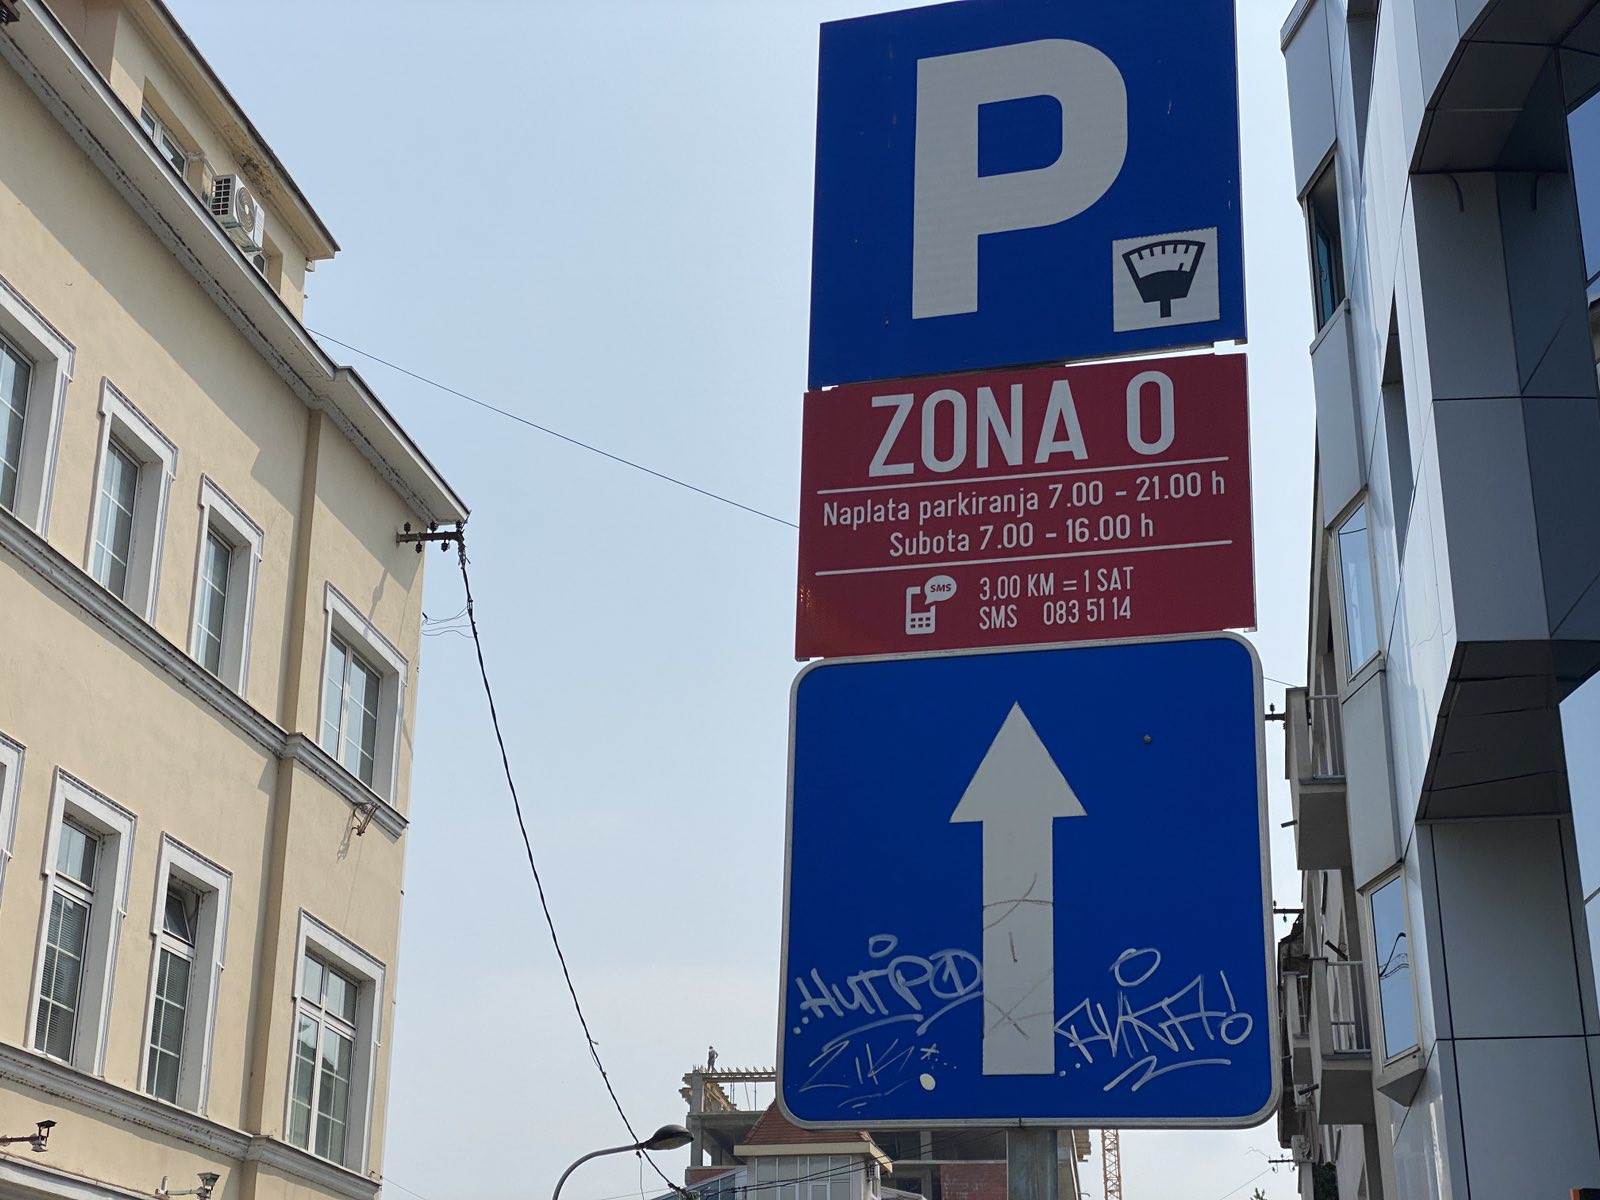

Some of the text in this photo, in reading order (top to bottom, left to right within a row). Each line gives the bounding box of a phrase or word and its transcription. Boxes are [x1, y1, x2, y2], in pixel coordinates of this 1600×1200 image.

[912, 38, 1128, 319] P
[869, 379, 1088, 477] ZONA
[824, 498, 909, 530] Naplata
[918, 488, 1038, 525] parkiranja
[1049, 481, 1103, 508] 7.00
[1136, 472, 1201, 501] 21.00
[1212, 471, 1224, 494] h
[890, 529, 969, 556] Subota
[980, 522, 1033, 550] 7.00
[1066, 515, 1130, 543] 16.00
[1141, 513, 1153, 537] h
[930, 583, 952, 593] SMS
[980, 567, 1133, 600] 3,00 KM = 1 SAT
[980, 605, 1017, 630] SMS
[1044, 600, 1079, 625] 083
